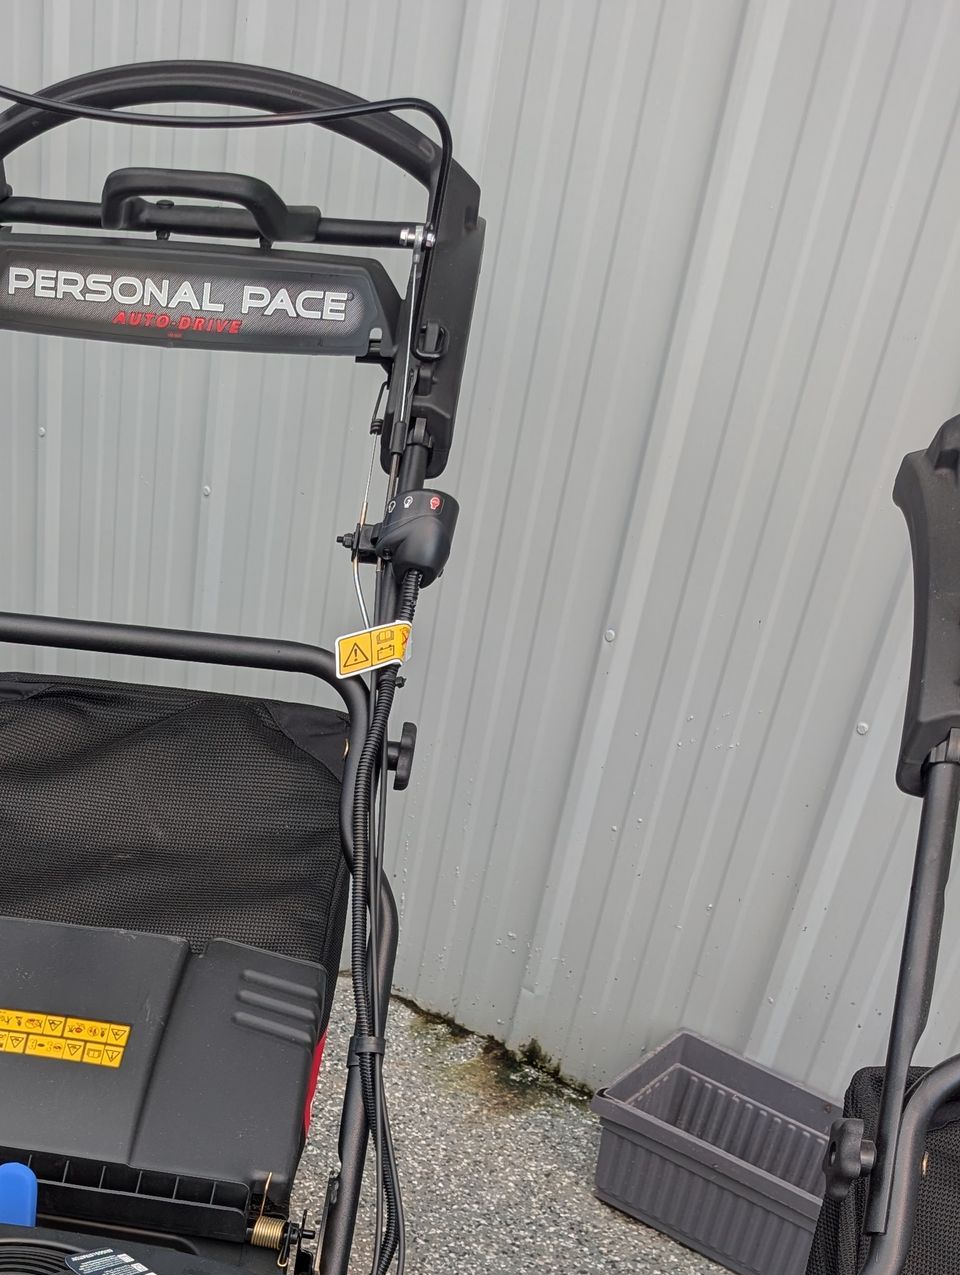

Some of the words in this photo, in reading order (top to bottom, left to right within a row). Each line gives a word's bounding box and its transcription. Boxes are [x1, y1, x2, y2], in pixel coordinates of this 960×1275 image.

[8, 267, 224, 312] PERSONAL
[241, 285, 348, 321] PACE
[112, 310, 241, 334] AUTO-DRIVE
